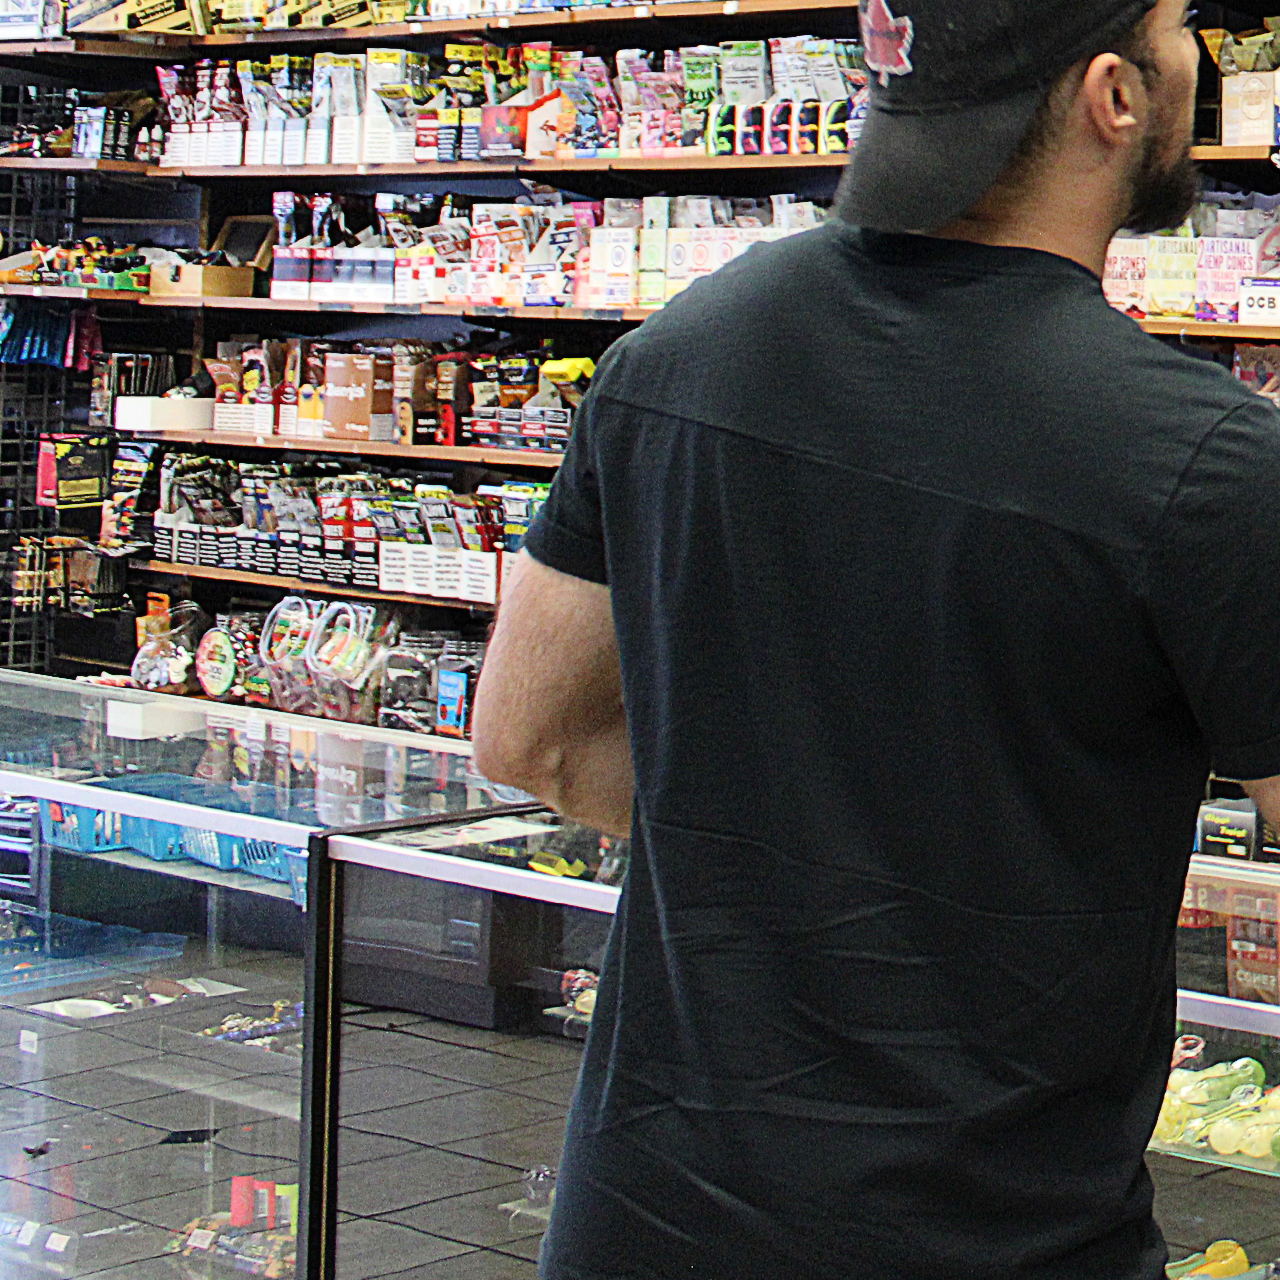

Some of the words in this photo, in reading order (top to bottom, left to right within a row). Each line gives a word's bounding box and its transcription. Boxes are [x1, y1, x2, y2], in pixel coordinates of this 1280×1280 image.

[1120, 256, 1146, 270] CONES
[1227, 256, 1254, 270] CONES
[1246, 296, 1277, 308] OCB
